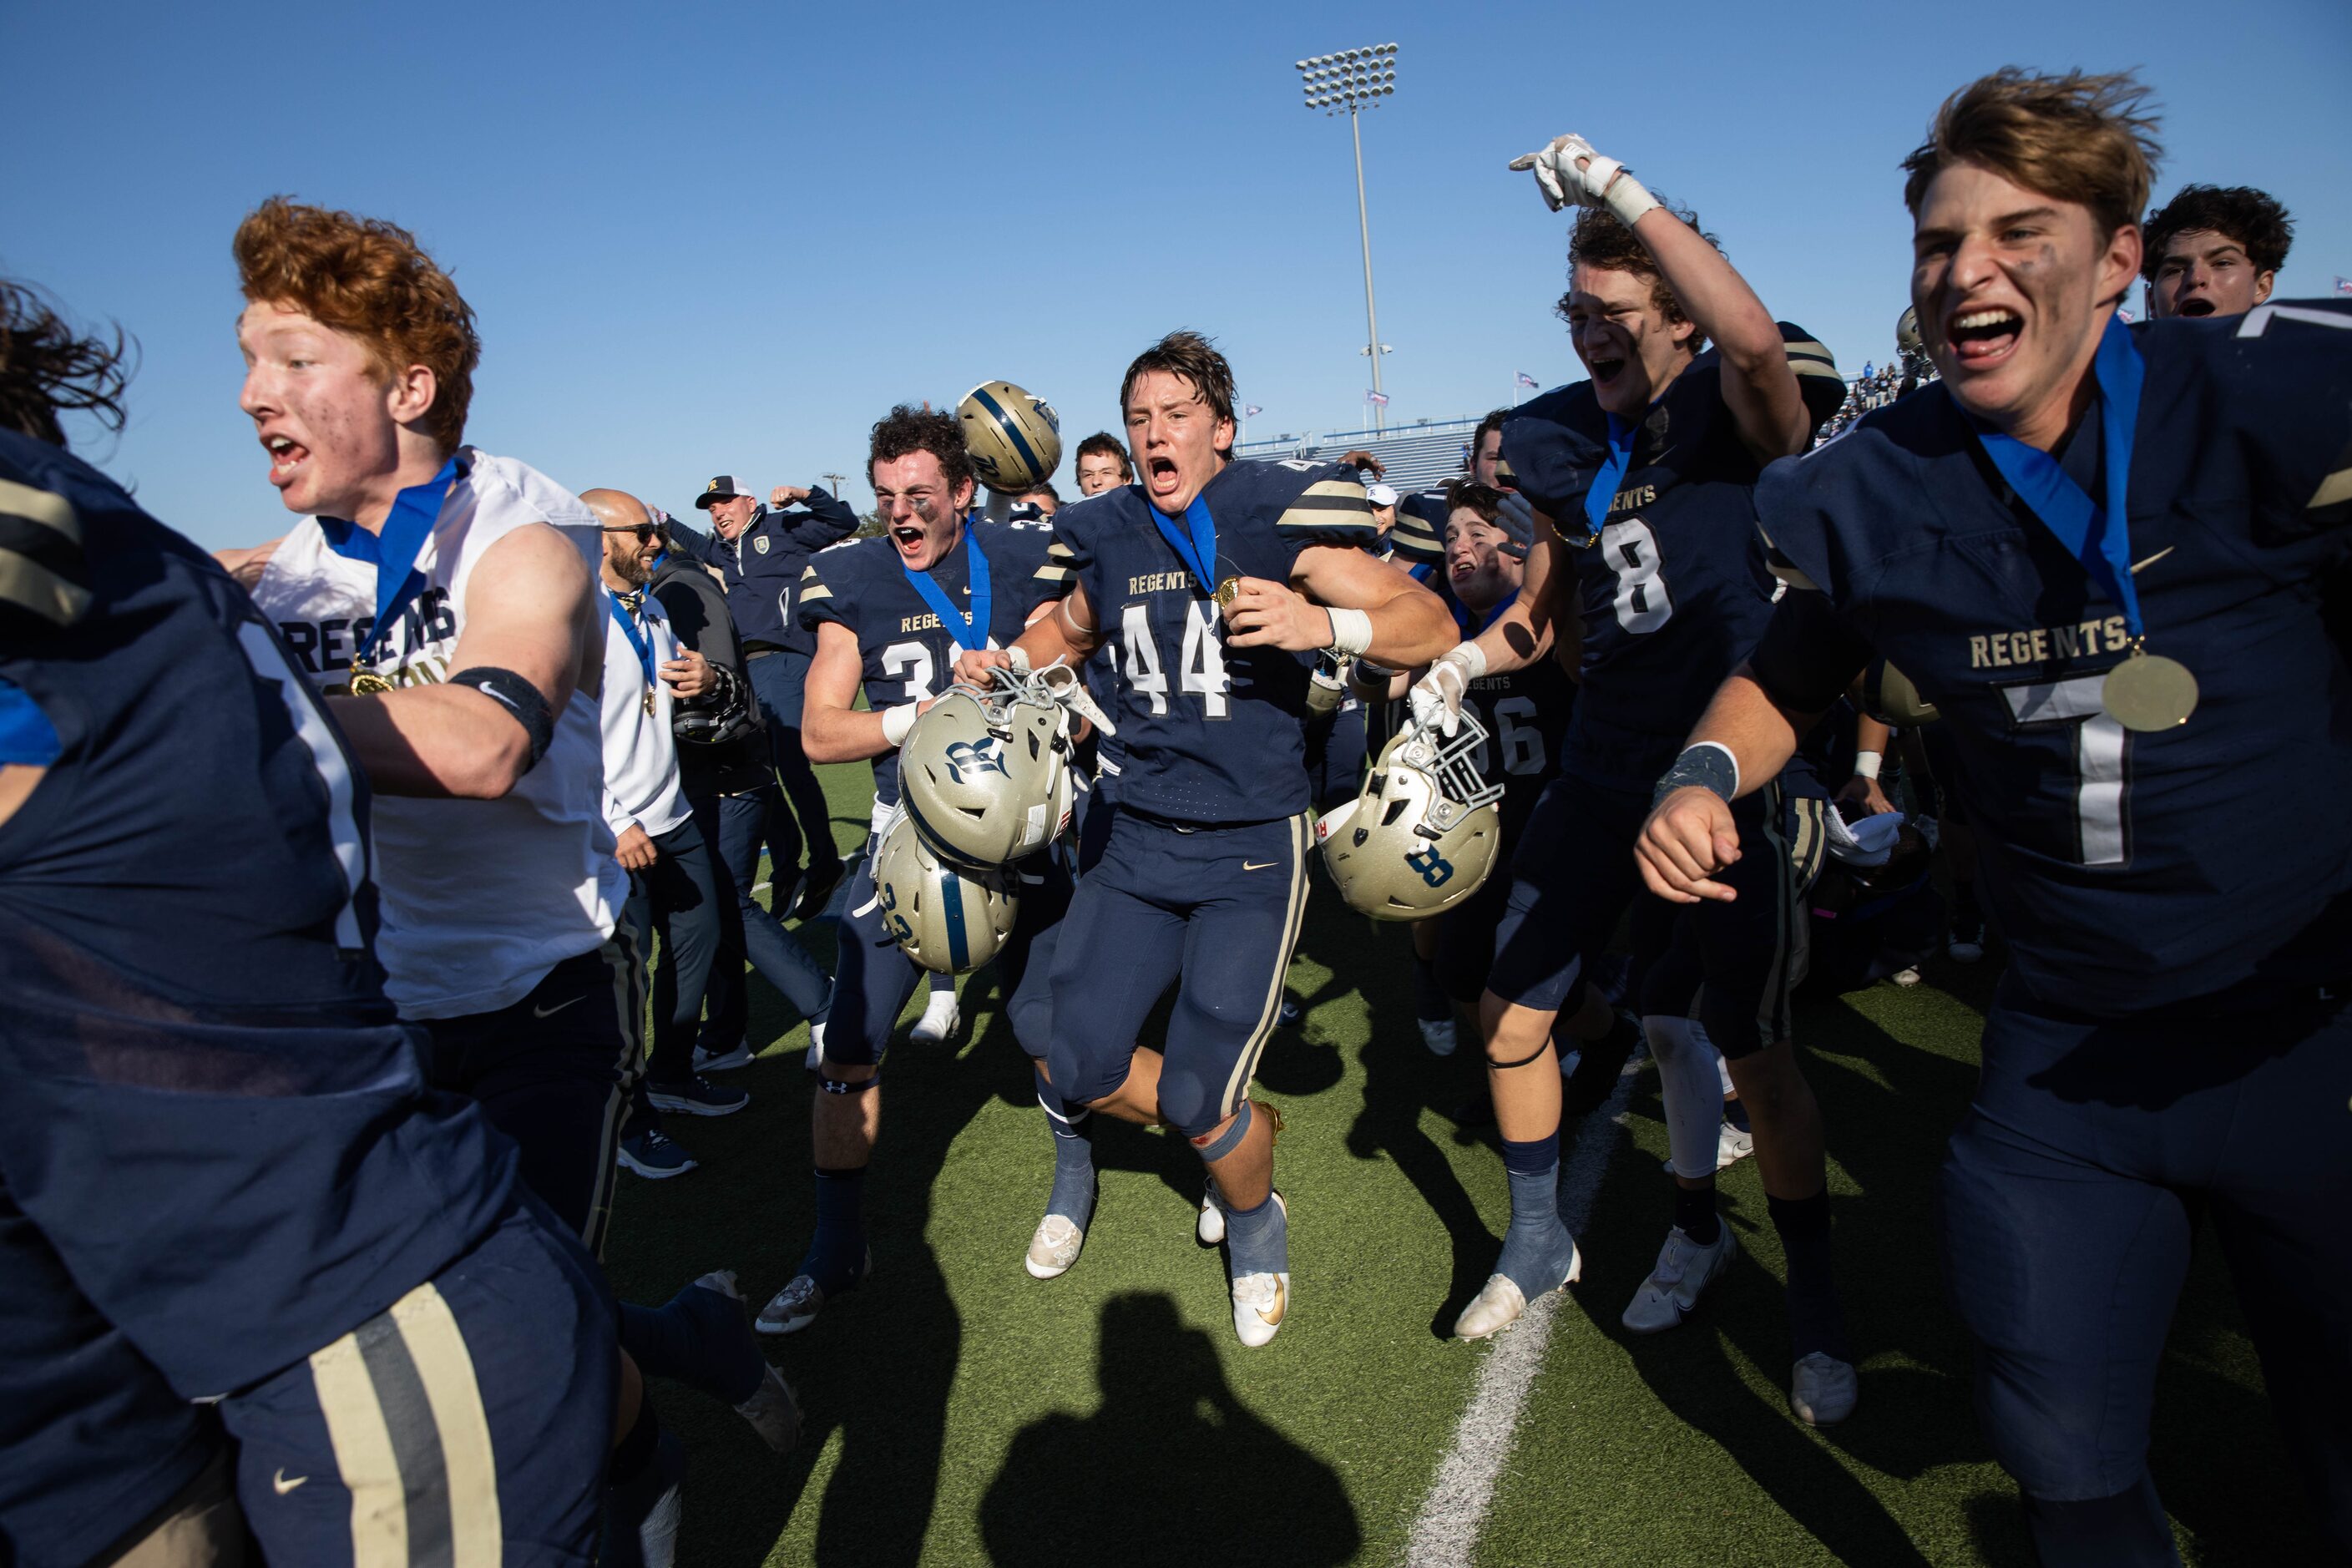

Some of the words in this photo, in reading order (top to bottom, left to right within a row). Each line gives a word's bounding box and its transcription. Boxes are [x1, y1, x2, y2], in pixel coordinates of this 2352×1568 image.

[1128, 570, 1201, 595] REGENTS
[1601, 518, 1673, 635] 8
[1122, 599, 1232, 717] 44
[1969, 615, 2128, 669] REGENTS
[1404, 843, 1454, 888] 8
